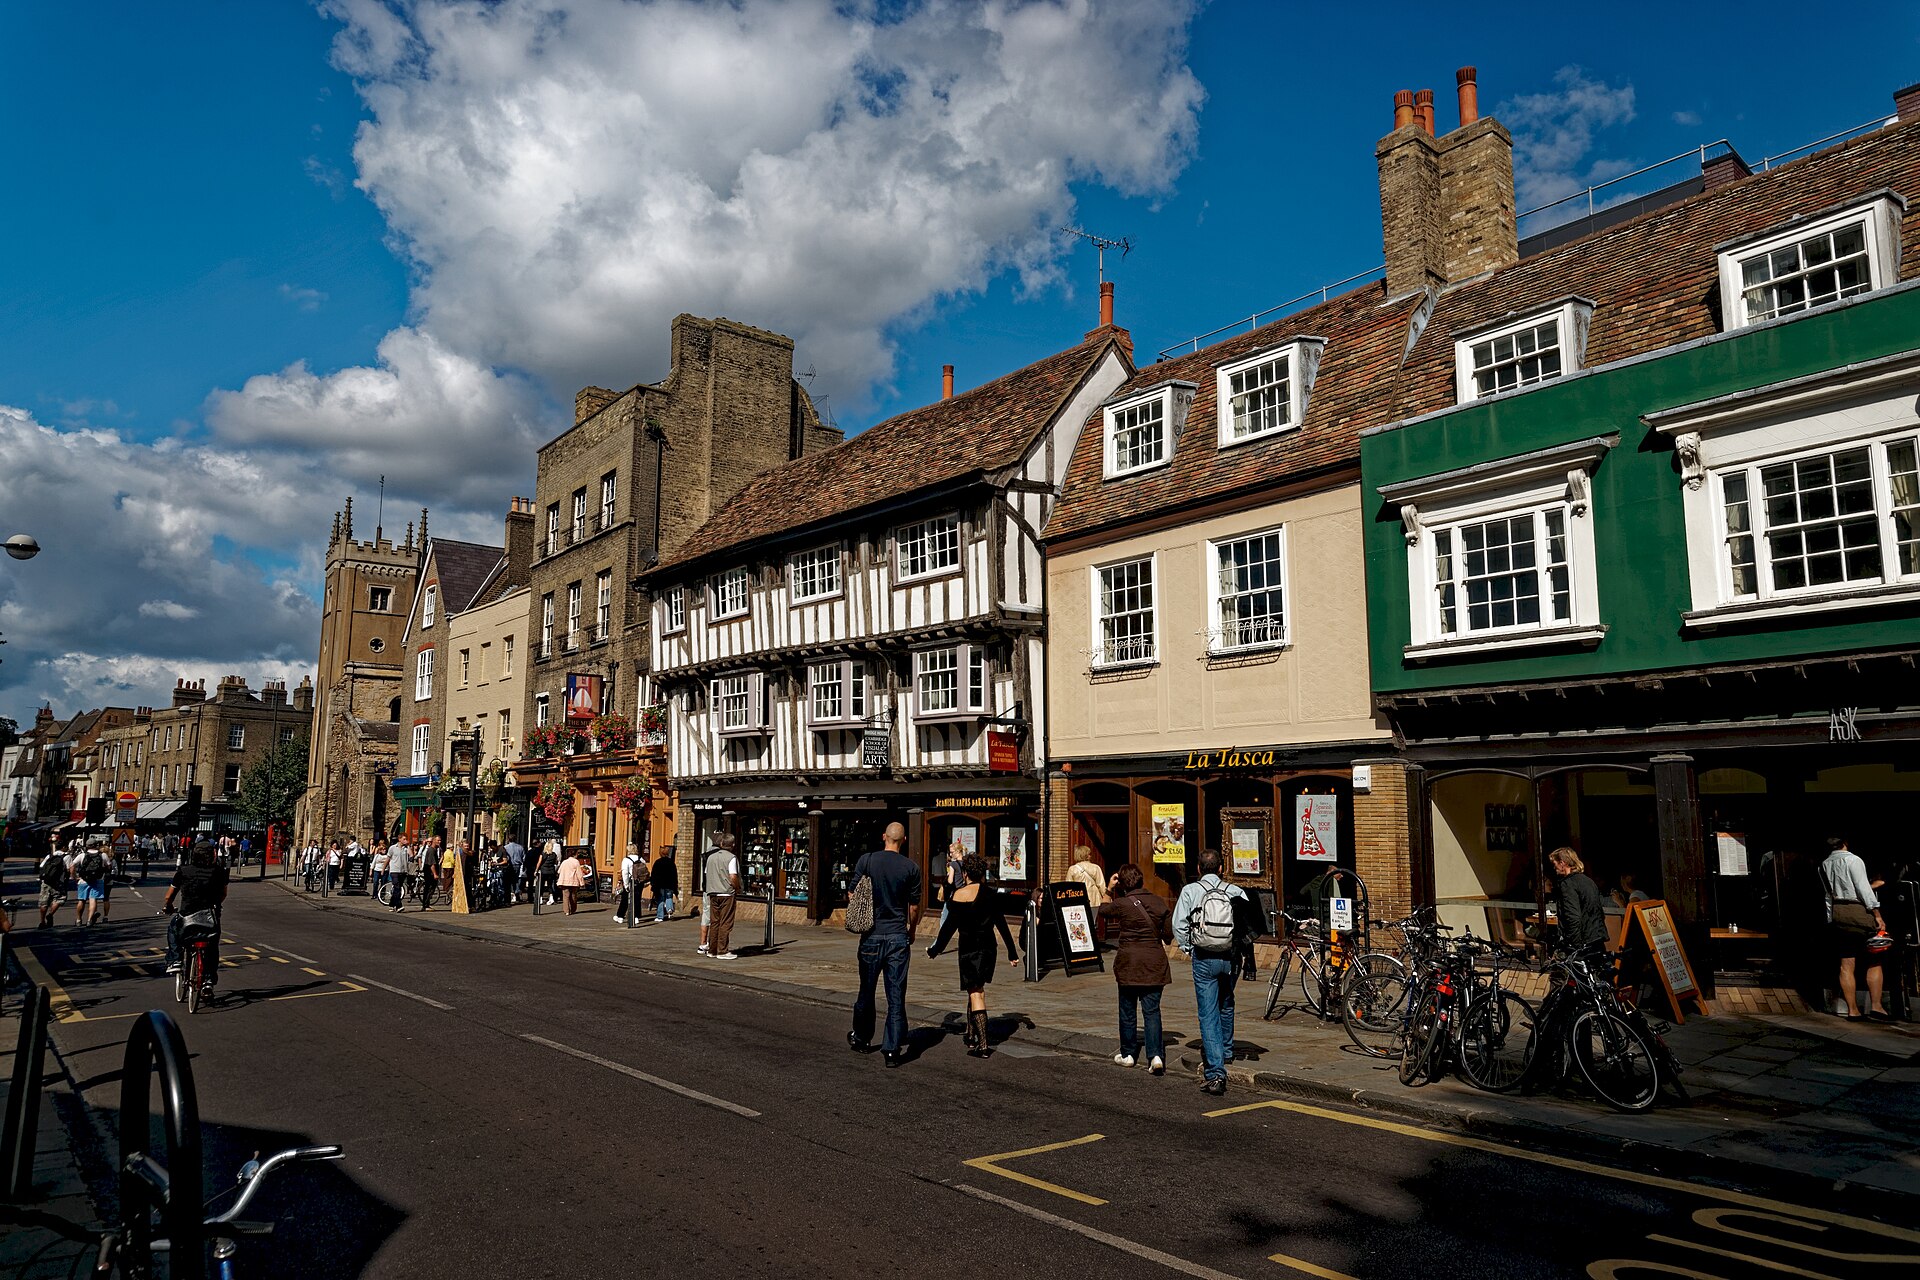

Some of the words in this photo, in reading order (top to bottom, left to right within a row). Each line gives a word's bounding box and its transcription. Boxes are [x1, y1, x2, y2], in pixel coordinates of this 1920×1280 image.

[1829, 706, 1862, 741] ASK
[990, 739, 998, 747] La
[864, 754, 888, 765] ARTS
[1184, 750, 1212, 769] La
[1214, 745, 1277, 768] Tasca
[971, 798, 982, 807] BAR
[1168, 847, 1183, 855] £1.50
[1057, 890, 1066, 899] La
[1066, 889, 1084, 898] Tasca
